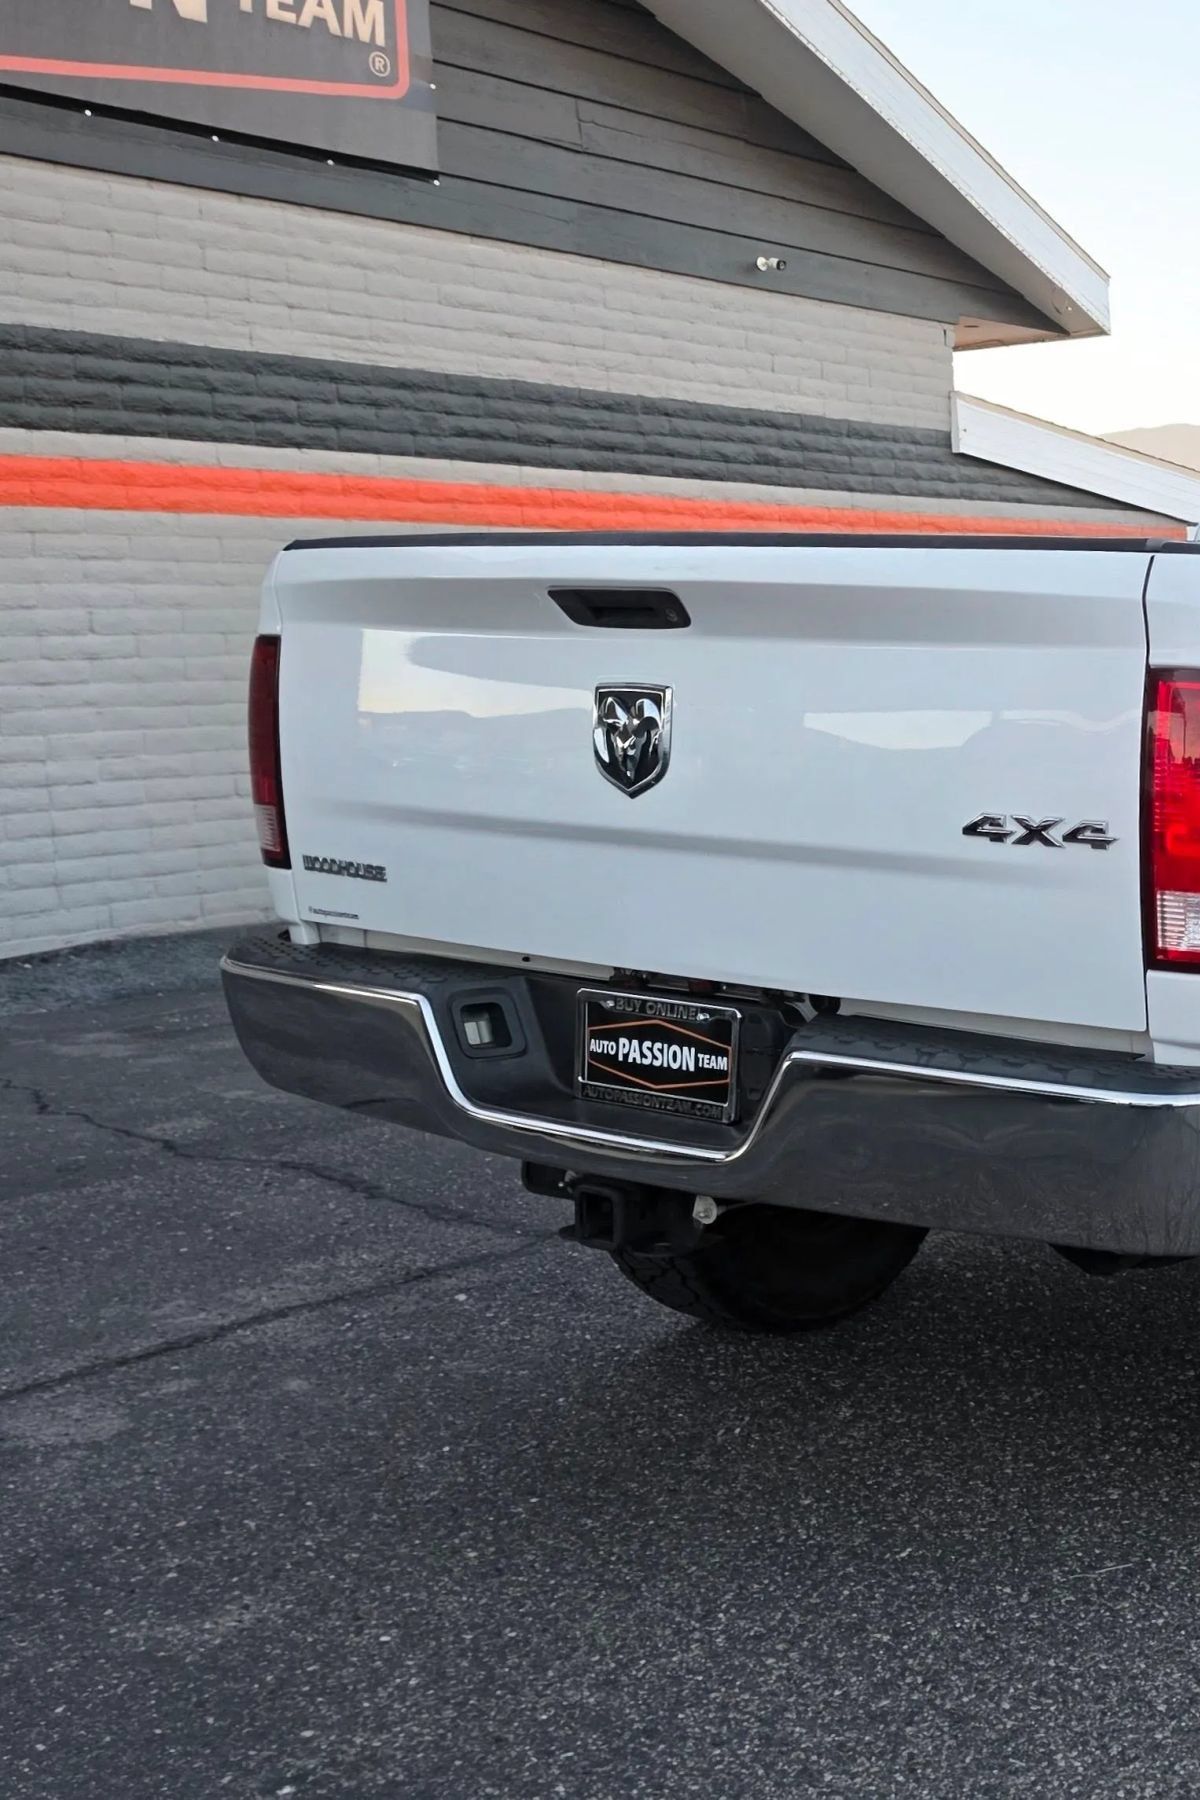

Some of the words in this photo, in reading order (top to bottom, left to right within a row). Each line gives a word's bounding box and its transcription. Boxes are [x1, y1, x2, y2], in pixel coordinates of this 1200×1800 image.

[962, 812, 1120, 850] 4X4
[615, 998, 643, 1011] BUY
[589, 1038, 617, 1055] AUTO
[618, 1037, 696, 1072] PASSION
[697, 1053, 728, 1071] TEAM
